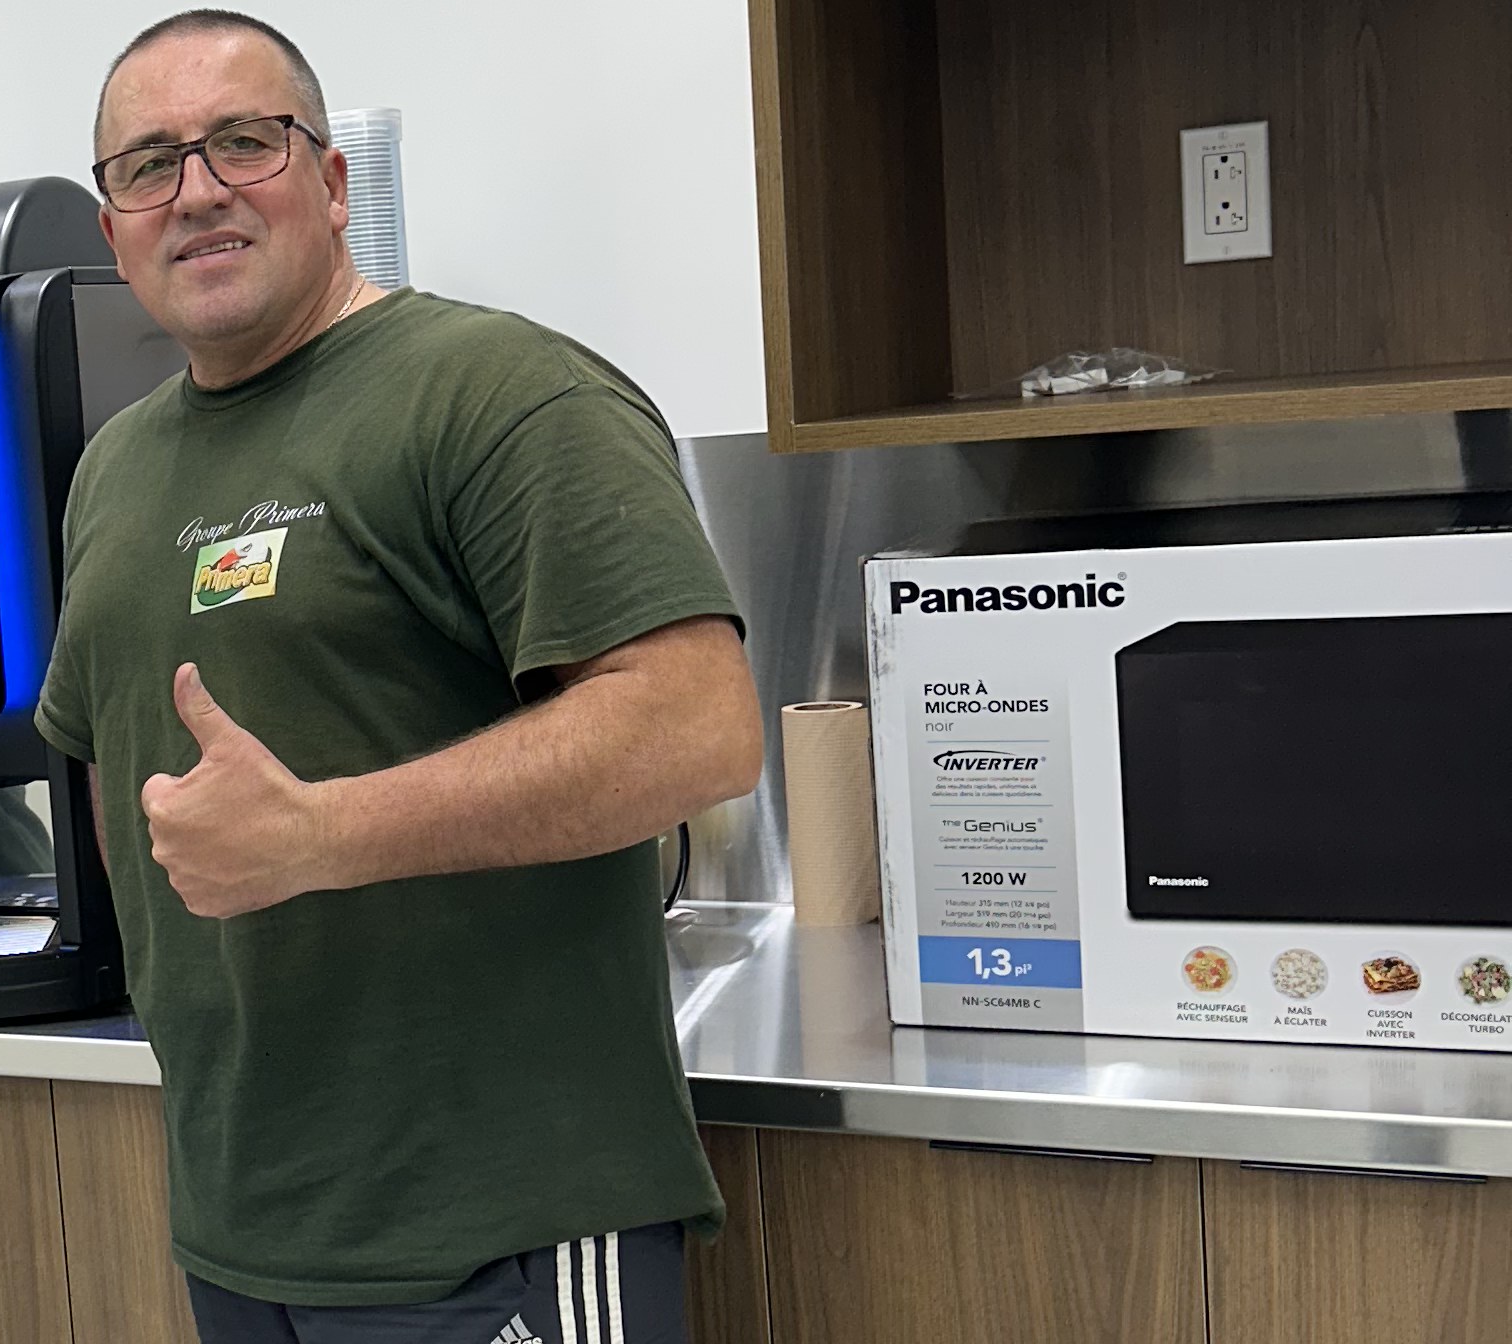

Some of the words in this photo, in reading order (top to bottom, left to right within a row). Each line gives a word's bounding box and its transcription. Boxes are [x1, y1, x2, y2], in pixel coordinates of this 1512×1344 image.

[176, 517, 233, 553] Groupe
[238, 500, 326, 537] Primera
[194, 561, 272, 596] Primera
[890, 573, 1125, 615] Panasonic
[924, 682, 970, 696] FOUR
[975, 679, 988, 696] À
[925, 699, 1049, 714] MICRO-ONDES
[925, 721, 954, 732] noir
[942, 757, 1039, 771] INVERTER
[964, 819, 1037, 833] Genius
[961, 872, 1004, 886] 1200
[1008, 872, 1027, 886] W
[1148, 876, 1209, 887] Panasonic
[966, 947, 1012, 979] 1,3
[962, 996, 1031, 1009] NN-SC64MB
[1033, 999, 1042, 1009] C
[1177, 1001, 1247, 1013] RÉCHAUFFAGE
[1287, 1006, 1313, 1016] MAÏS
[1367, 1009, 1413, 1019] CUISSON
[1176, 1013, 1203, 1023] AVEC
[1204, 1013, 1248, 1024] SENSEUR
[1274, 1016, 1282, 1025] À
[1284, 1016, 1328, 1027] ÉCLATER
[1441, 1012, 1512, 1023] DÉCONGÉLAT
[1377, 1020, 1404, 1029] AVEC
[1469, 1024, 1505, 1034] TURBO
[1366, 1029, 1416, 1039] INVERTER
